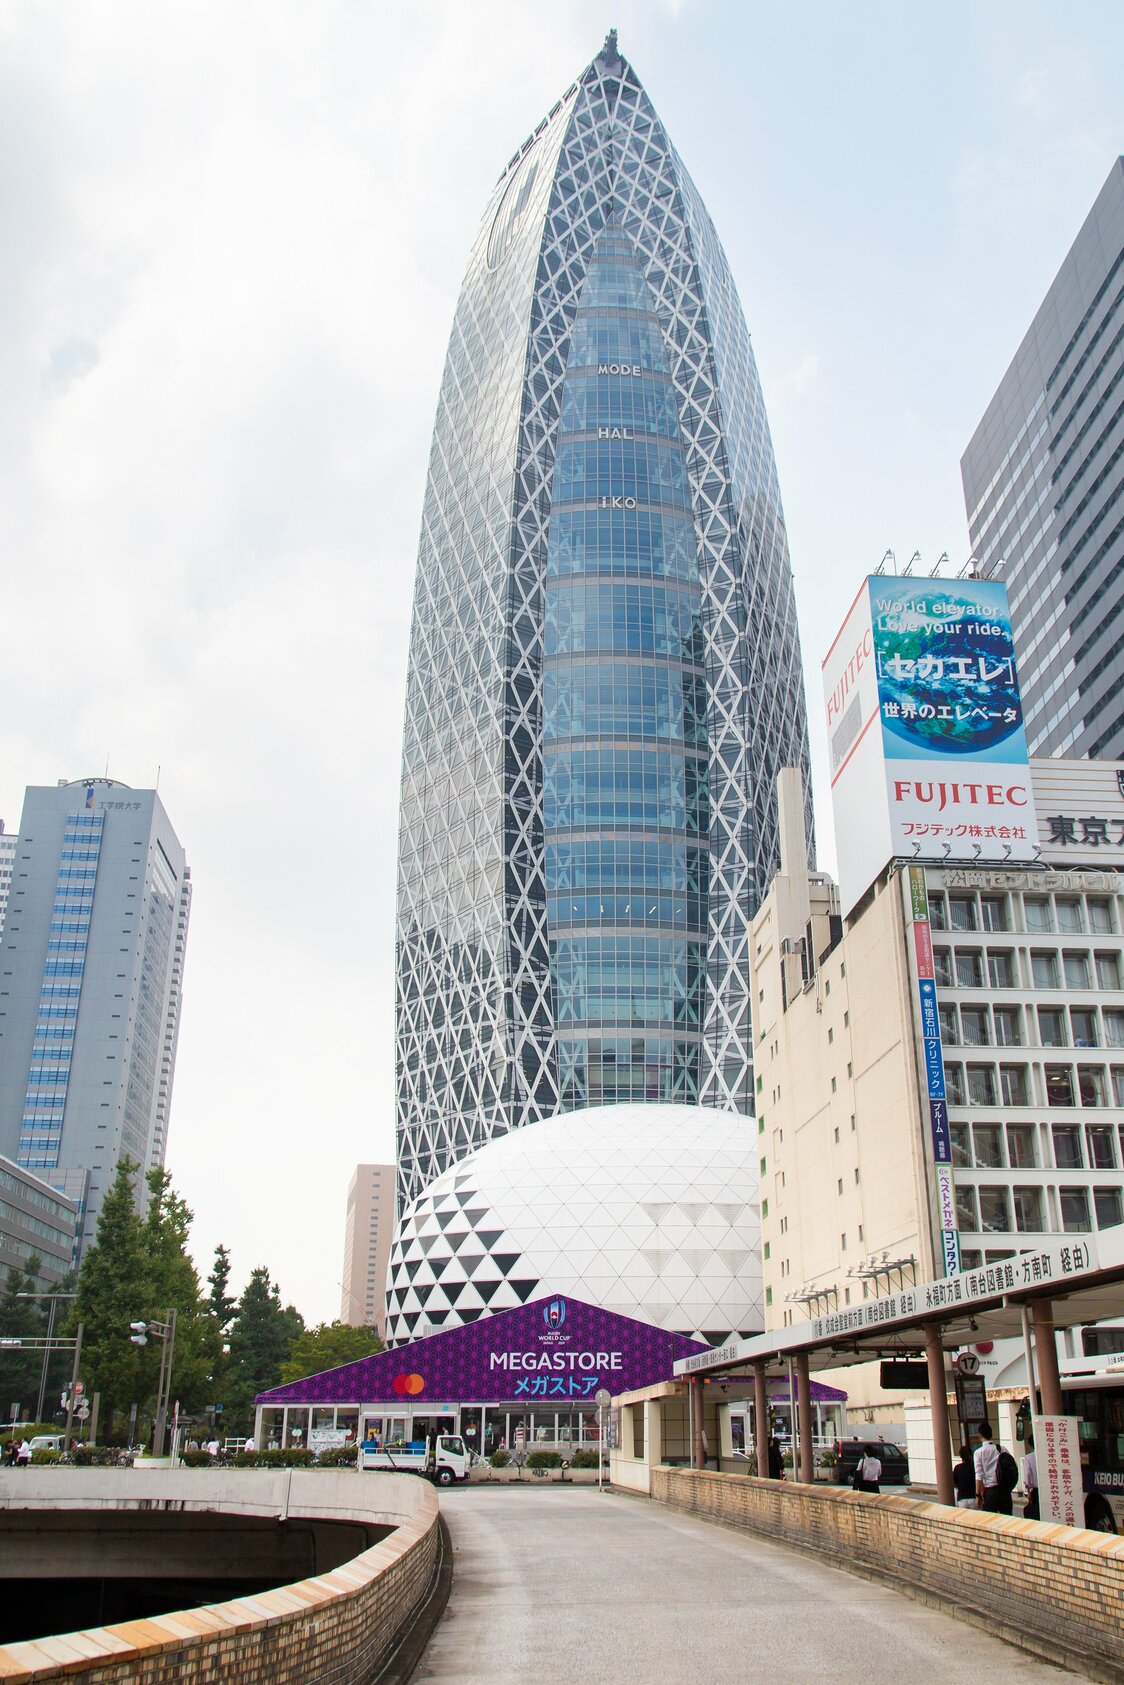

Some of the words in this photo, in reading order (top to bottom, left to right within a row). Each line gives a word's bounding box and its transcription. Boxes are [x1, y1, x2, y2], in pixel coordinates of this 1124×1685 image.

[598, 364, 642, 376] MODE
[598, 427, 634, 440] HAL
[876, 599, 927, 614] World
[932, 601, 1004, 617] elevator.
[877, 619, 919, 633] Love
[924, 621, 962, 636] your
[967, 622, 1007, 637] ride.
[827, 629, 872, 727] FUJITEC
[882, 702, 1018, 723] 世界のエレベータ
[98, 801, 142, 810] 工学院大学
[894, 781, 1028, 812] FUJITEC
[901, 822, 1027, 840] フジテック株式会社
[943, 869, 1121, 892] 松岡セントラルビル
[911, 879, 920, 913] ハローワーク
[933, 1102, 944, 1133] ブルーム
[940, 1176, 953, 1228] ベストメガネ
[490, 1352, 623, 1370] MEGASTORE
[961, 1357, 977, 1370] 17
[514, 1375, 599, 1396] メガストア
[1094, 1472, 1112, 1486] KEIO
[1112, 1473, 1124, 1487] BU
